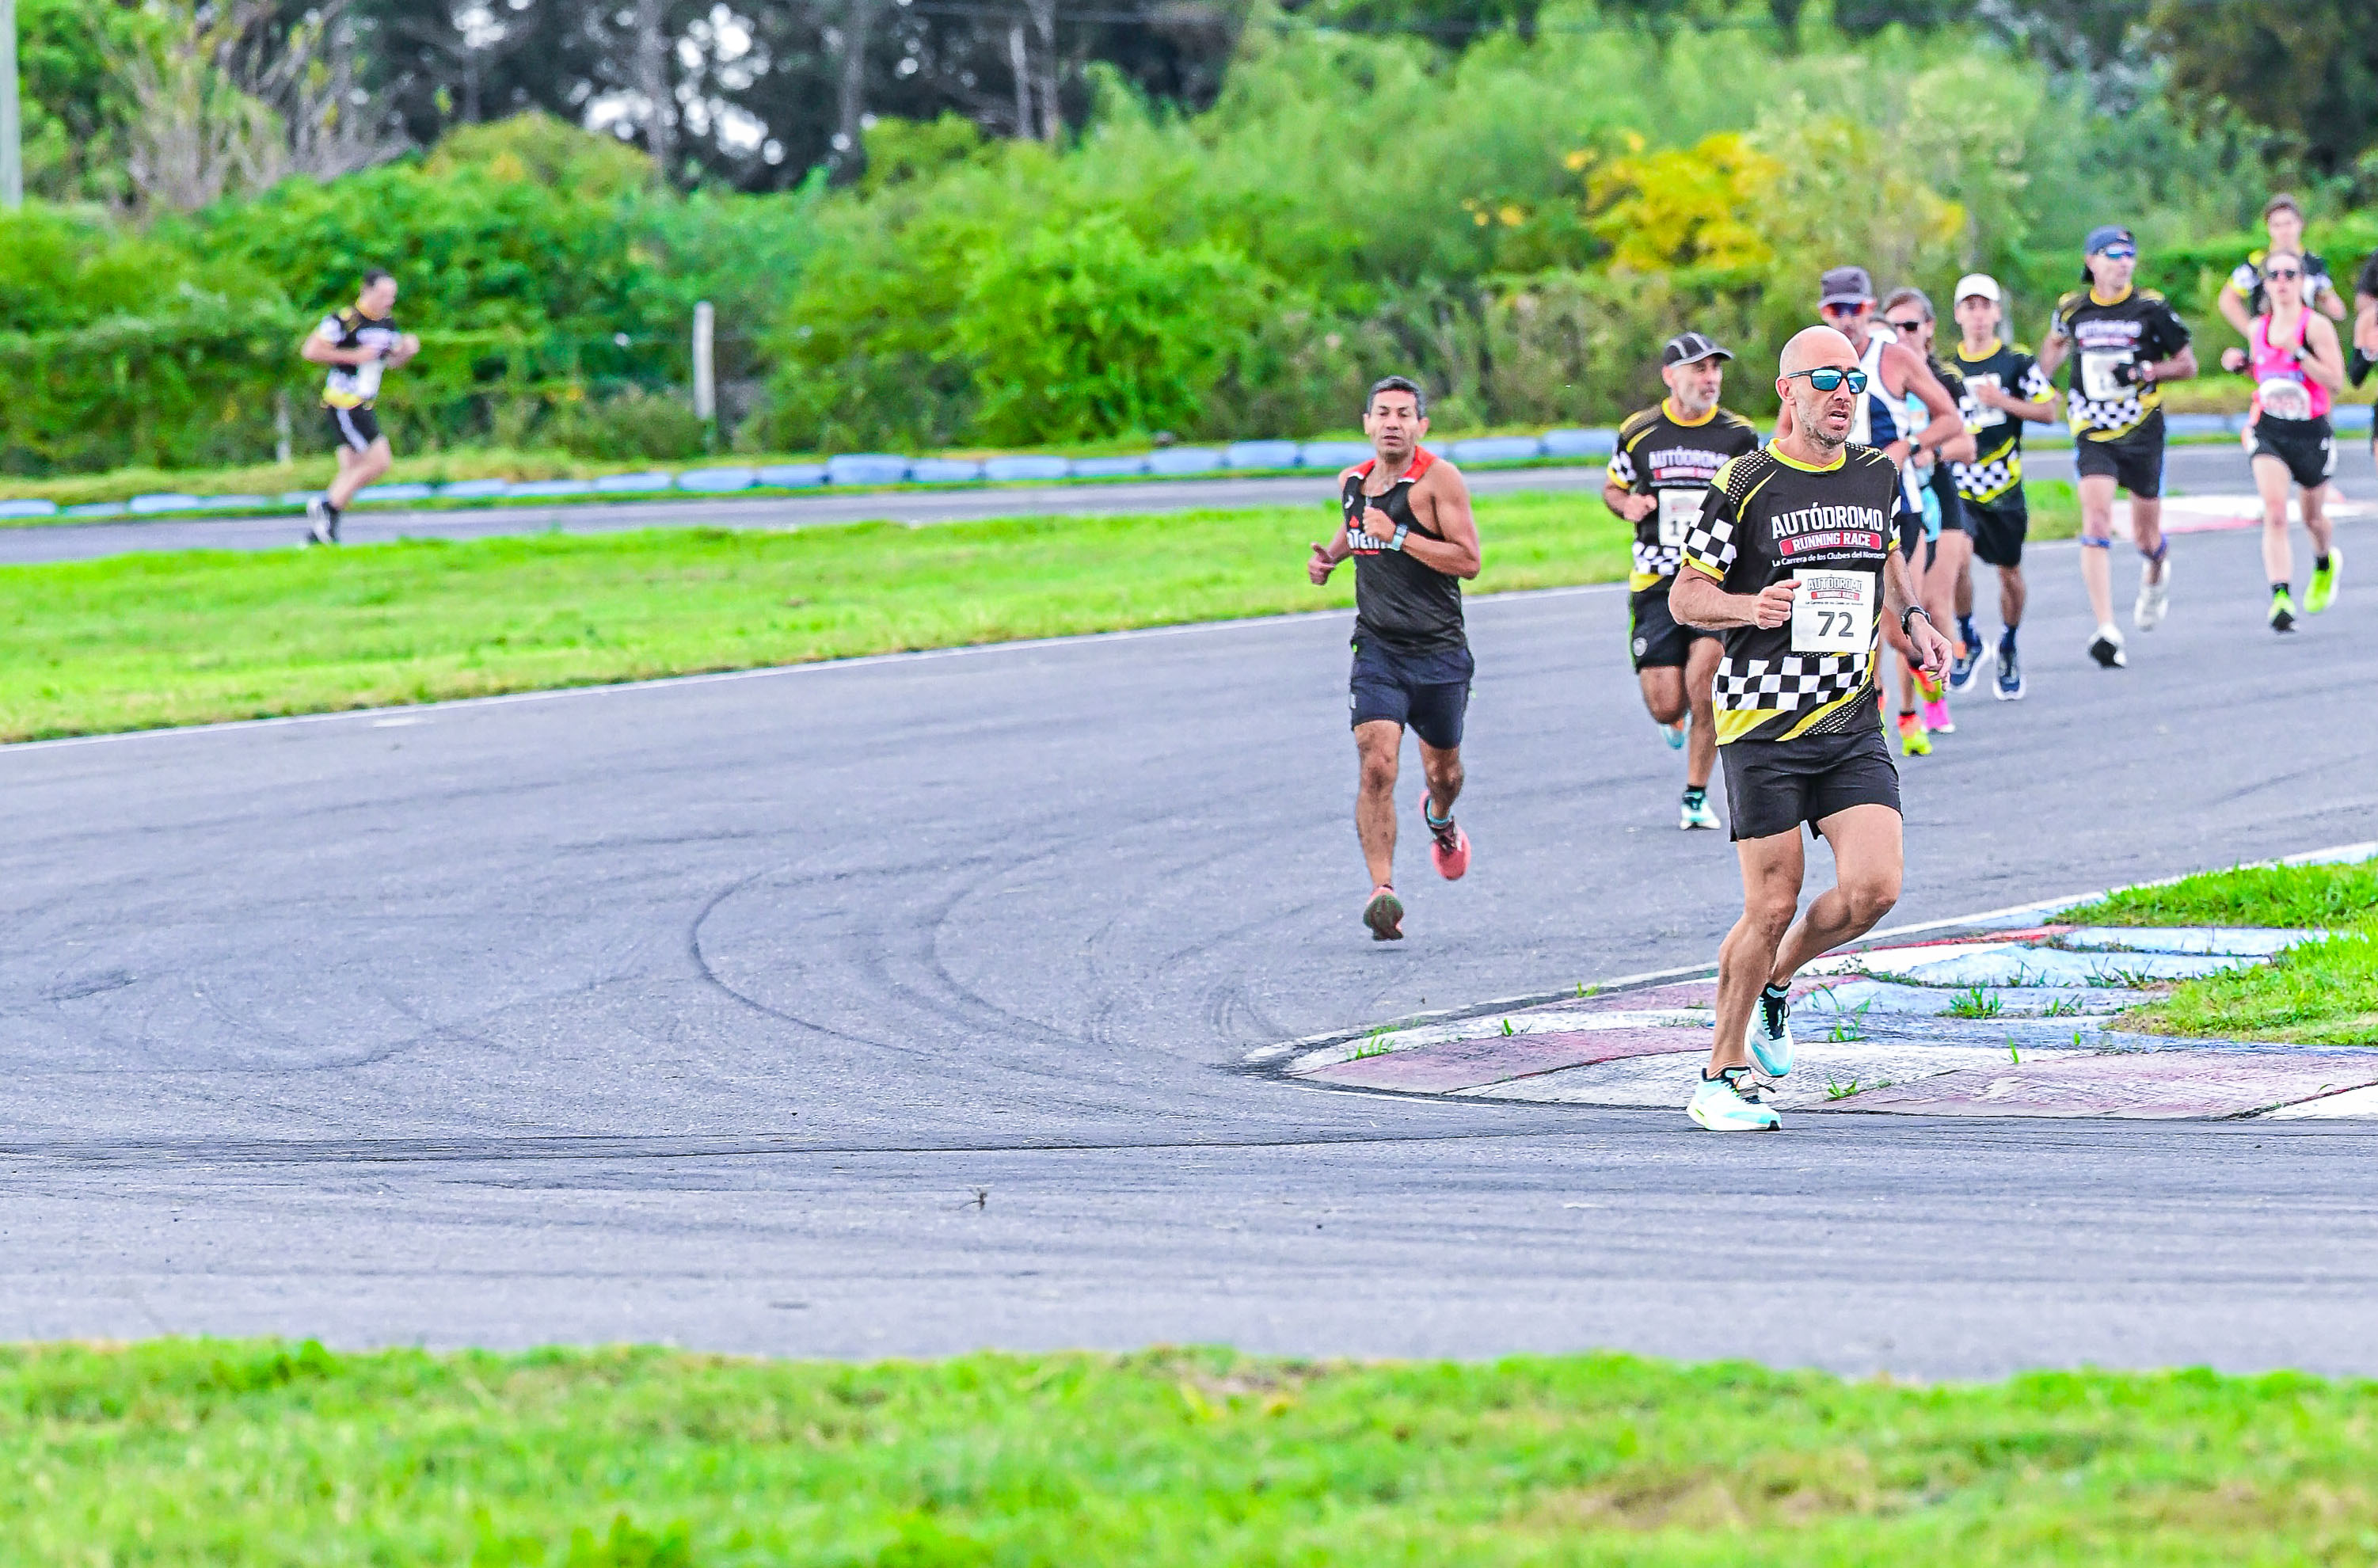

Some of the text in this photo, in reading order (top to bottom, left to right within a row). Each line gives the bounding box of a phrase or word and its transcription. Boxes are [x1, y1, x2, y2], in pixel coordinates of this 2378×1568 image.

[1771, 501, 1884, 539] AUTÓDROMO
[1791, 532, 1871, 552] RUNNING RACE
[1771, 559, 1781, 568] La
[1781, 555, 1807, 565] Carrera
[1817, 552, 1826, 561] los
[1826, 551, 1851, 561] Clubes
[1851, 550, 1862, 559] del
[1817, 611, 1855, 637] 72
